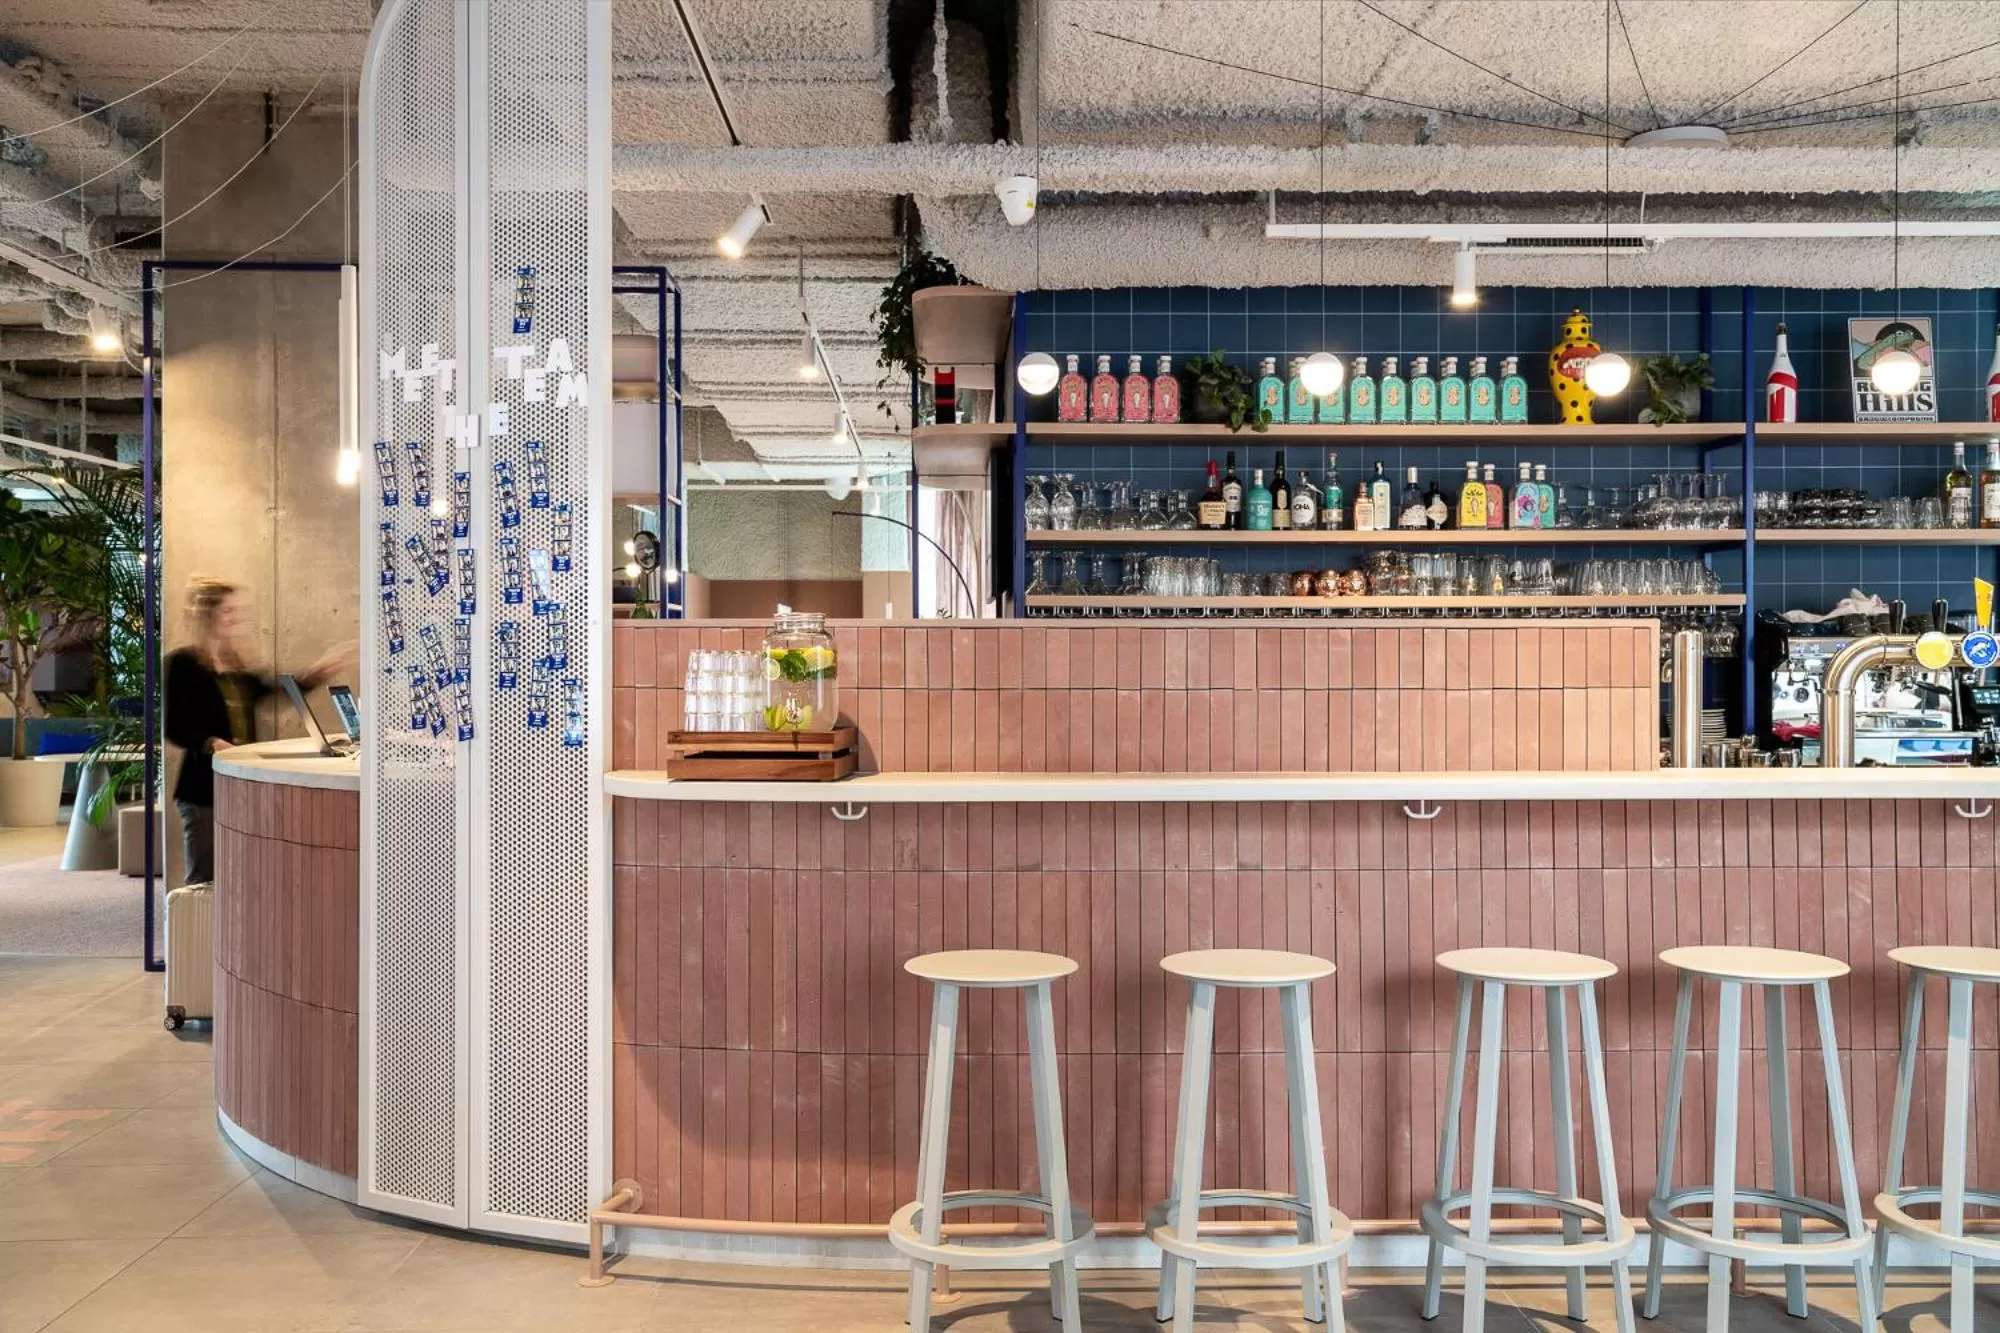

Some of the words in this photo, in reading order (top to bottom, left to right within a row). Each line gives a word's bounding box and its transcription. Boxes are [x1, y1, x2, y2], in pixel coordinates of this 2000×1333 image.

[380, 343, 456, 402] MEET
[441, 403, 508, 448] THE
[495, 338, 588, 407] TEAM
